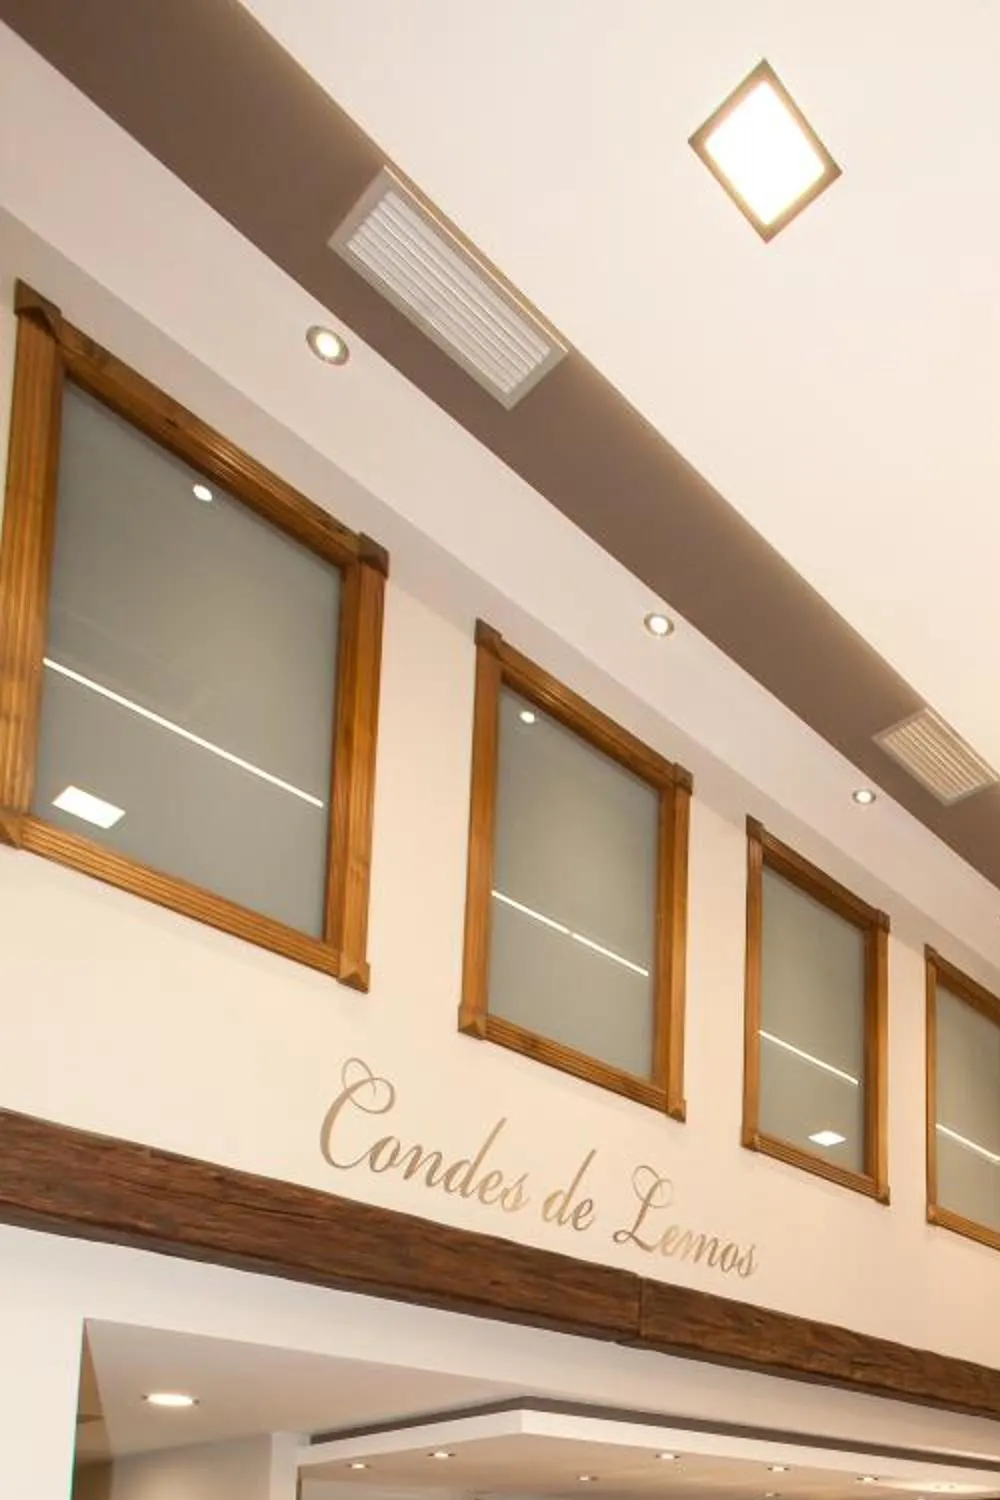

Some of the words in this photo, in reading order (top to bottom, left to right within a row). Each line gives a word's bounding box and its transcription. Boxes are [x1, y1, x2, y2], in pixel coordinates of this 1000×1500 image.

[319, 1057, 529, 1212] Condes
[541, 1148, 597, 1231] de
[612, 1165, 758, 1278] Lemos
